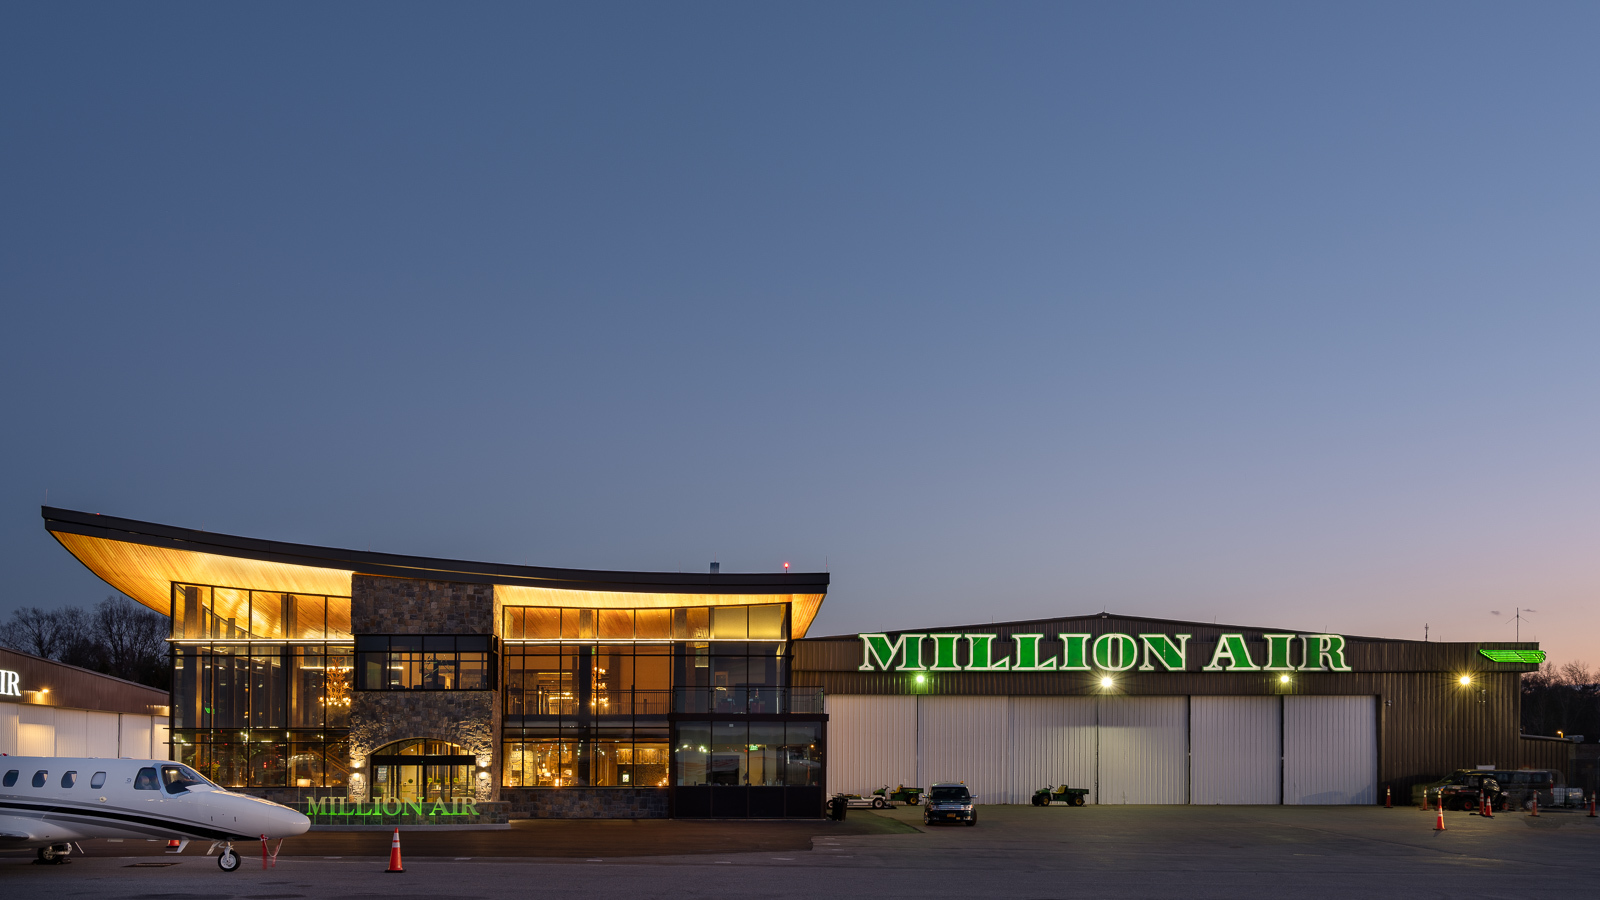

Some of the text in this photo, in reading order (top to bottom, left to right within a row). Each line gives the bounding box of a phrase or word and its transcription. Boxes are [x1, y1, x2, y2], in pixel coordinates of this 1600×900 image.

[858, 633, 1352, 672] MILLION AIR
[307, 796, 479, 816] MILLION AIR
